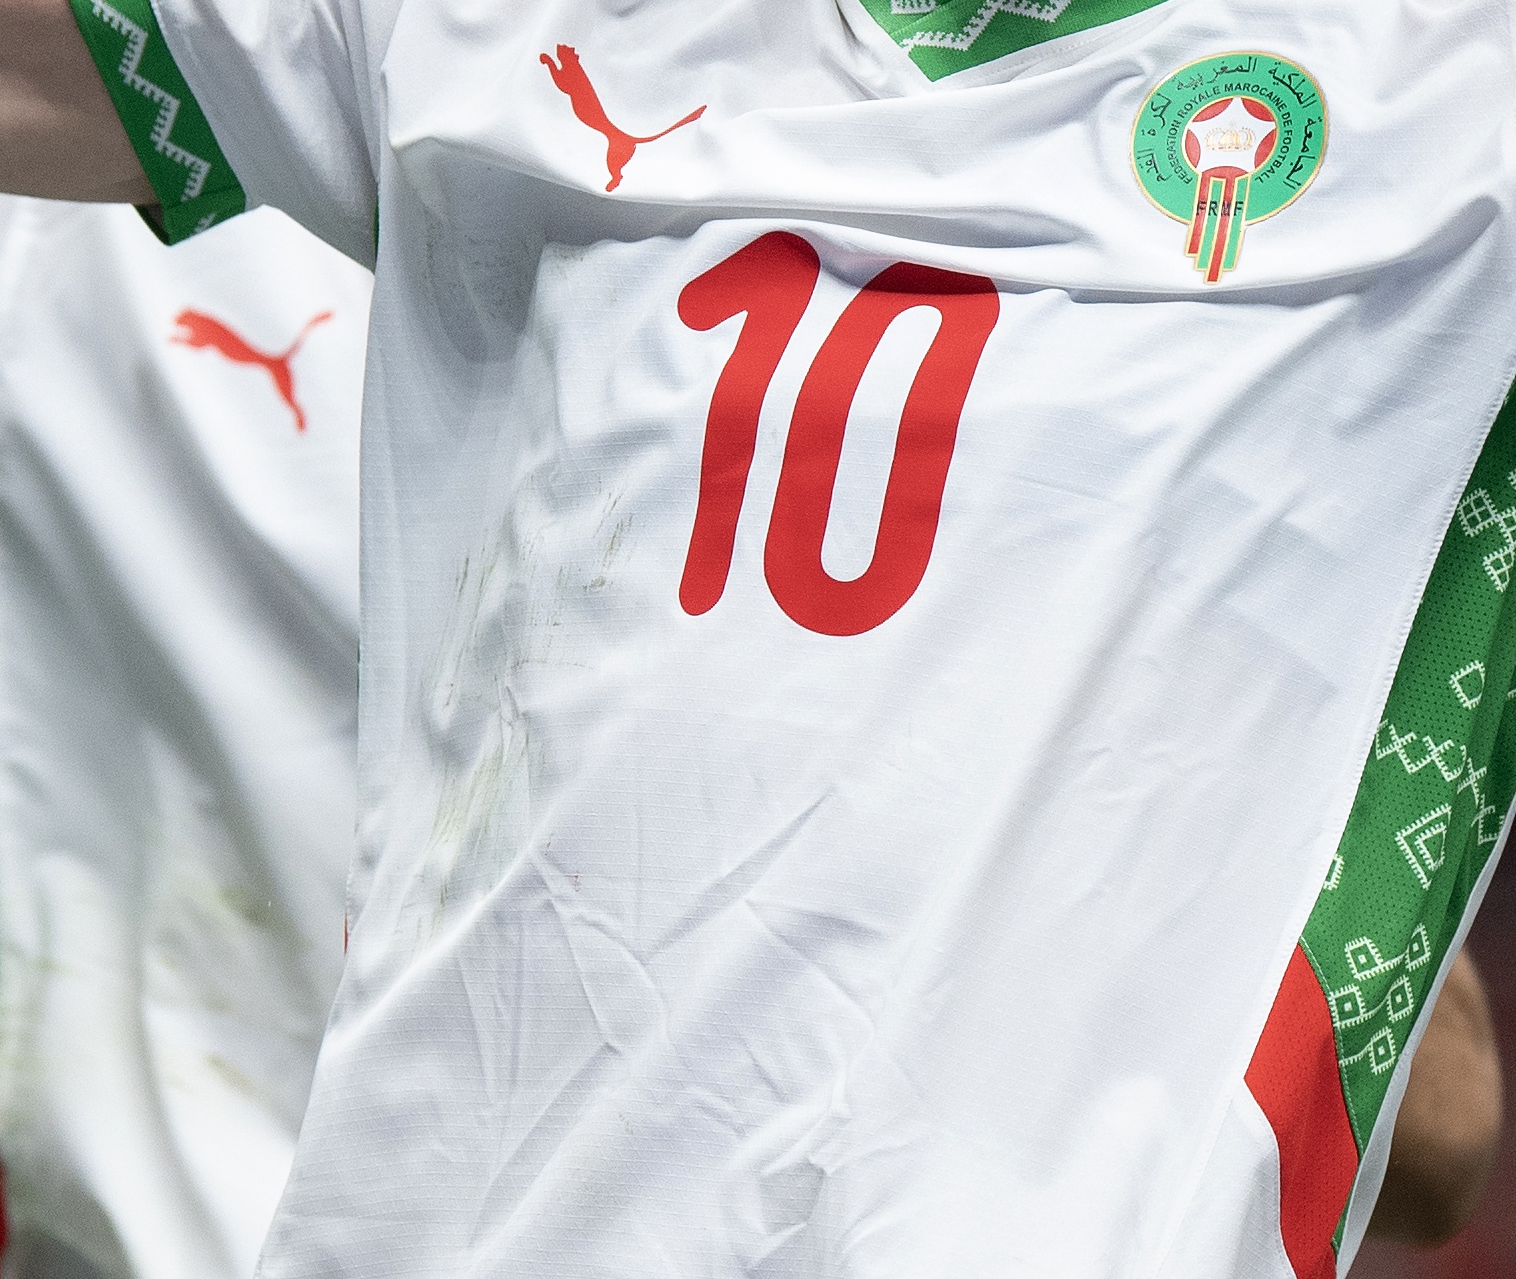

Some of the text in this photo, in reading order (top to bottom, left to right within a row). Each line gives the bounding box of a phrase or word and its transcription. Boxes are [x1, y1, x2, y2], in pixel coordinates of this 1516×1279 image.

[1268, 61, 1317, 109] الملكية
[1166, 82, 1293, 185] FEDERATION ROYALE MAROCAINE DE FOOTBALL
[1282, 116, 1323, 190] الجامعة
[1196, 200, 1244, 216] FRMF
[677, 230, 1000, 637] 10
